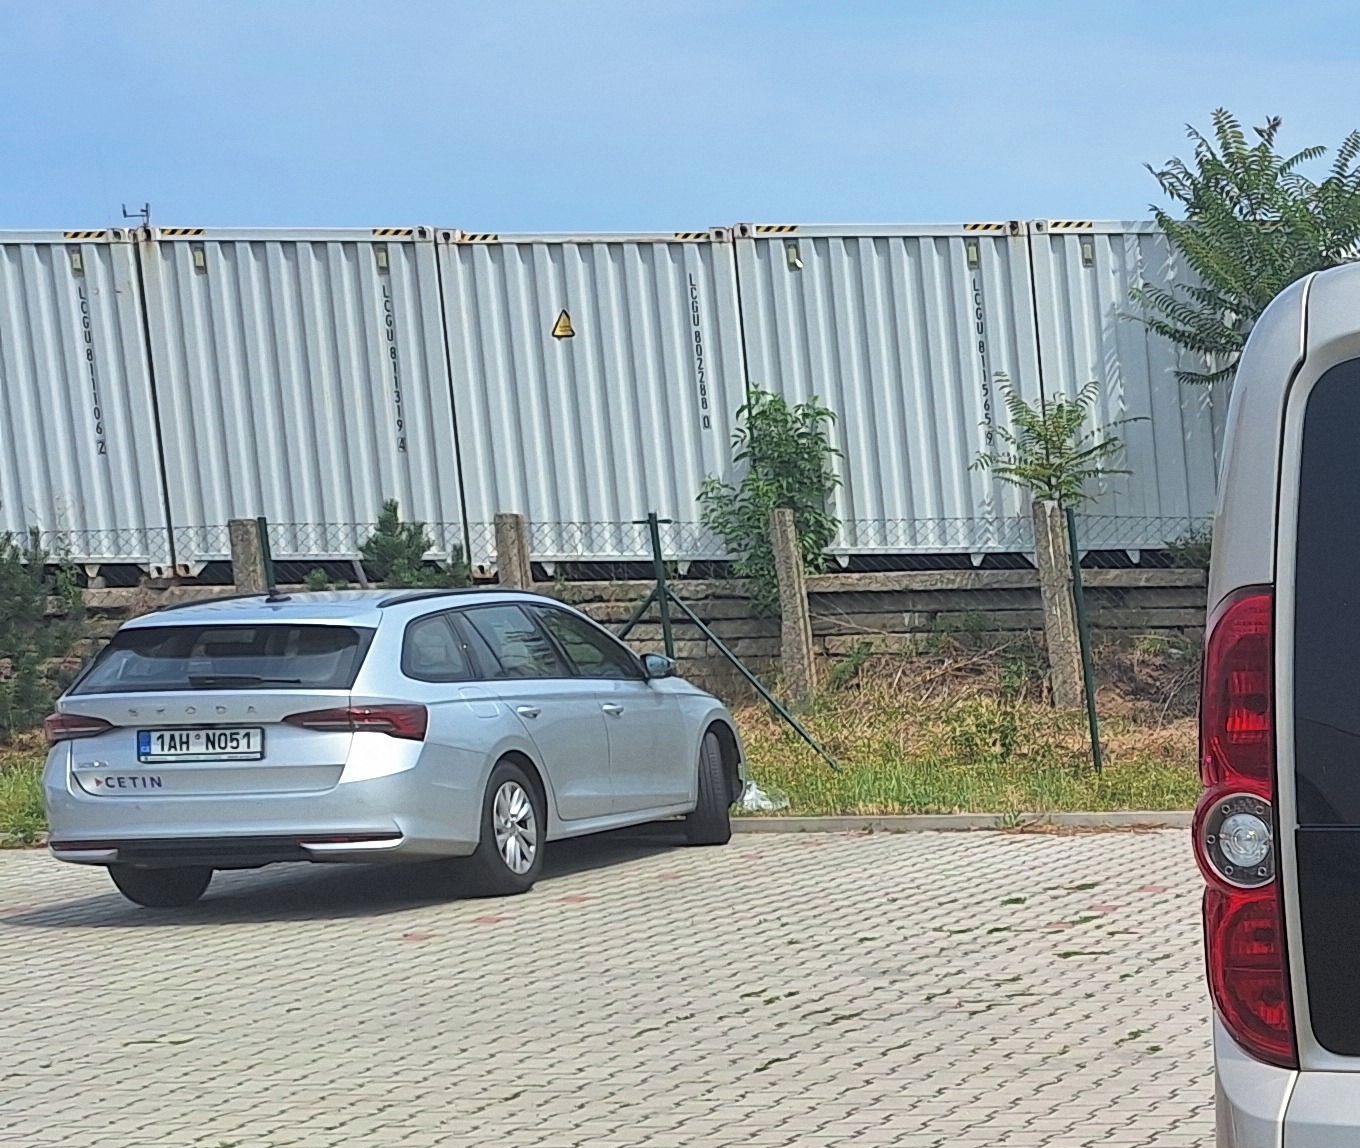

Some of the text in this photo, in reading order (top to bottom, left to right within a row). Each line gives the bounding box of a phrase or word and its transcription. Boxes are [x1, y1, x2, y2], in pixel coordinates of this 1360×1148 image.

[688, 272, 700, 327] LCGU
[973, 278, 984, 335] LCGU
[78, 286, 92, 344] LCGU
[86, 348, 103, 435] 811106
[382, 285, 394, 342] LCGU
[389, 346, 403, 432] 811319
[978, 340, 992, 425] 811565
[156, 731, 251, 752] 1AH N051
[105, 775, 163, 789] CETIN
